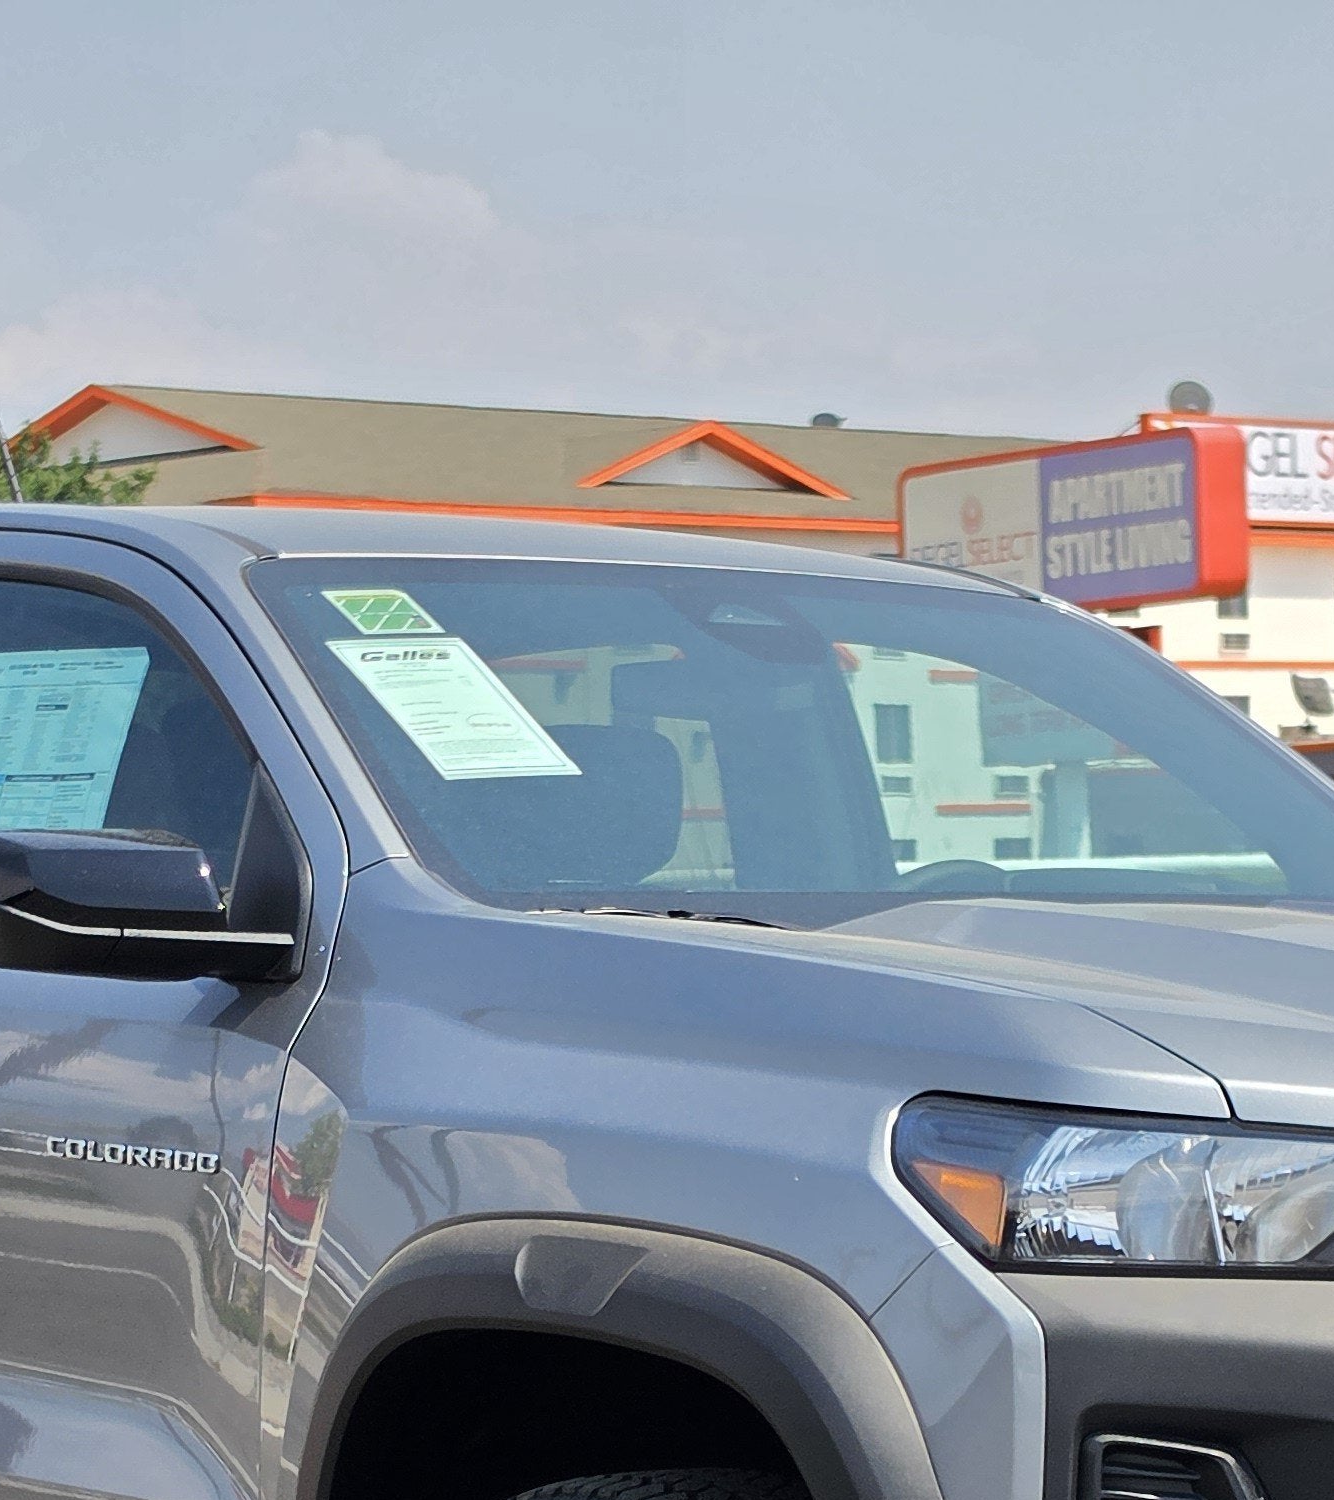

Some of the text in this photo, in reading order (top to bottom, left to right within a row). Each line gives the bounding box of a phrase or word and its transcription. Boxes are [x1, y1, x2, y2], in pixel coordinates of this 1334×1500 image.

[1048, 462, 1186, 524] APARTMENT
[966, 530, 1038, 567] SELECT
[1046, 519, 1193, 579] STYLE LIVING
[360, 650, 451, 662] Galles
[46, 1136, 220, 1174] COLORADO
